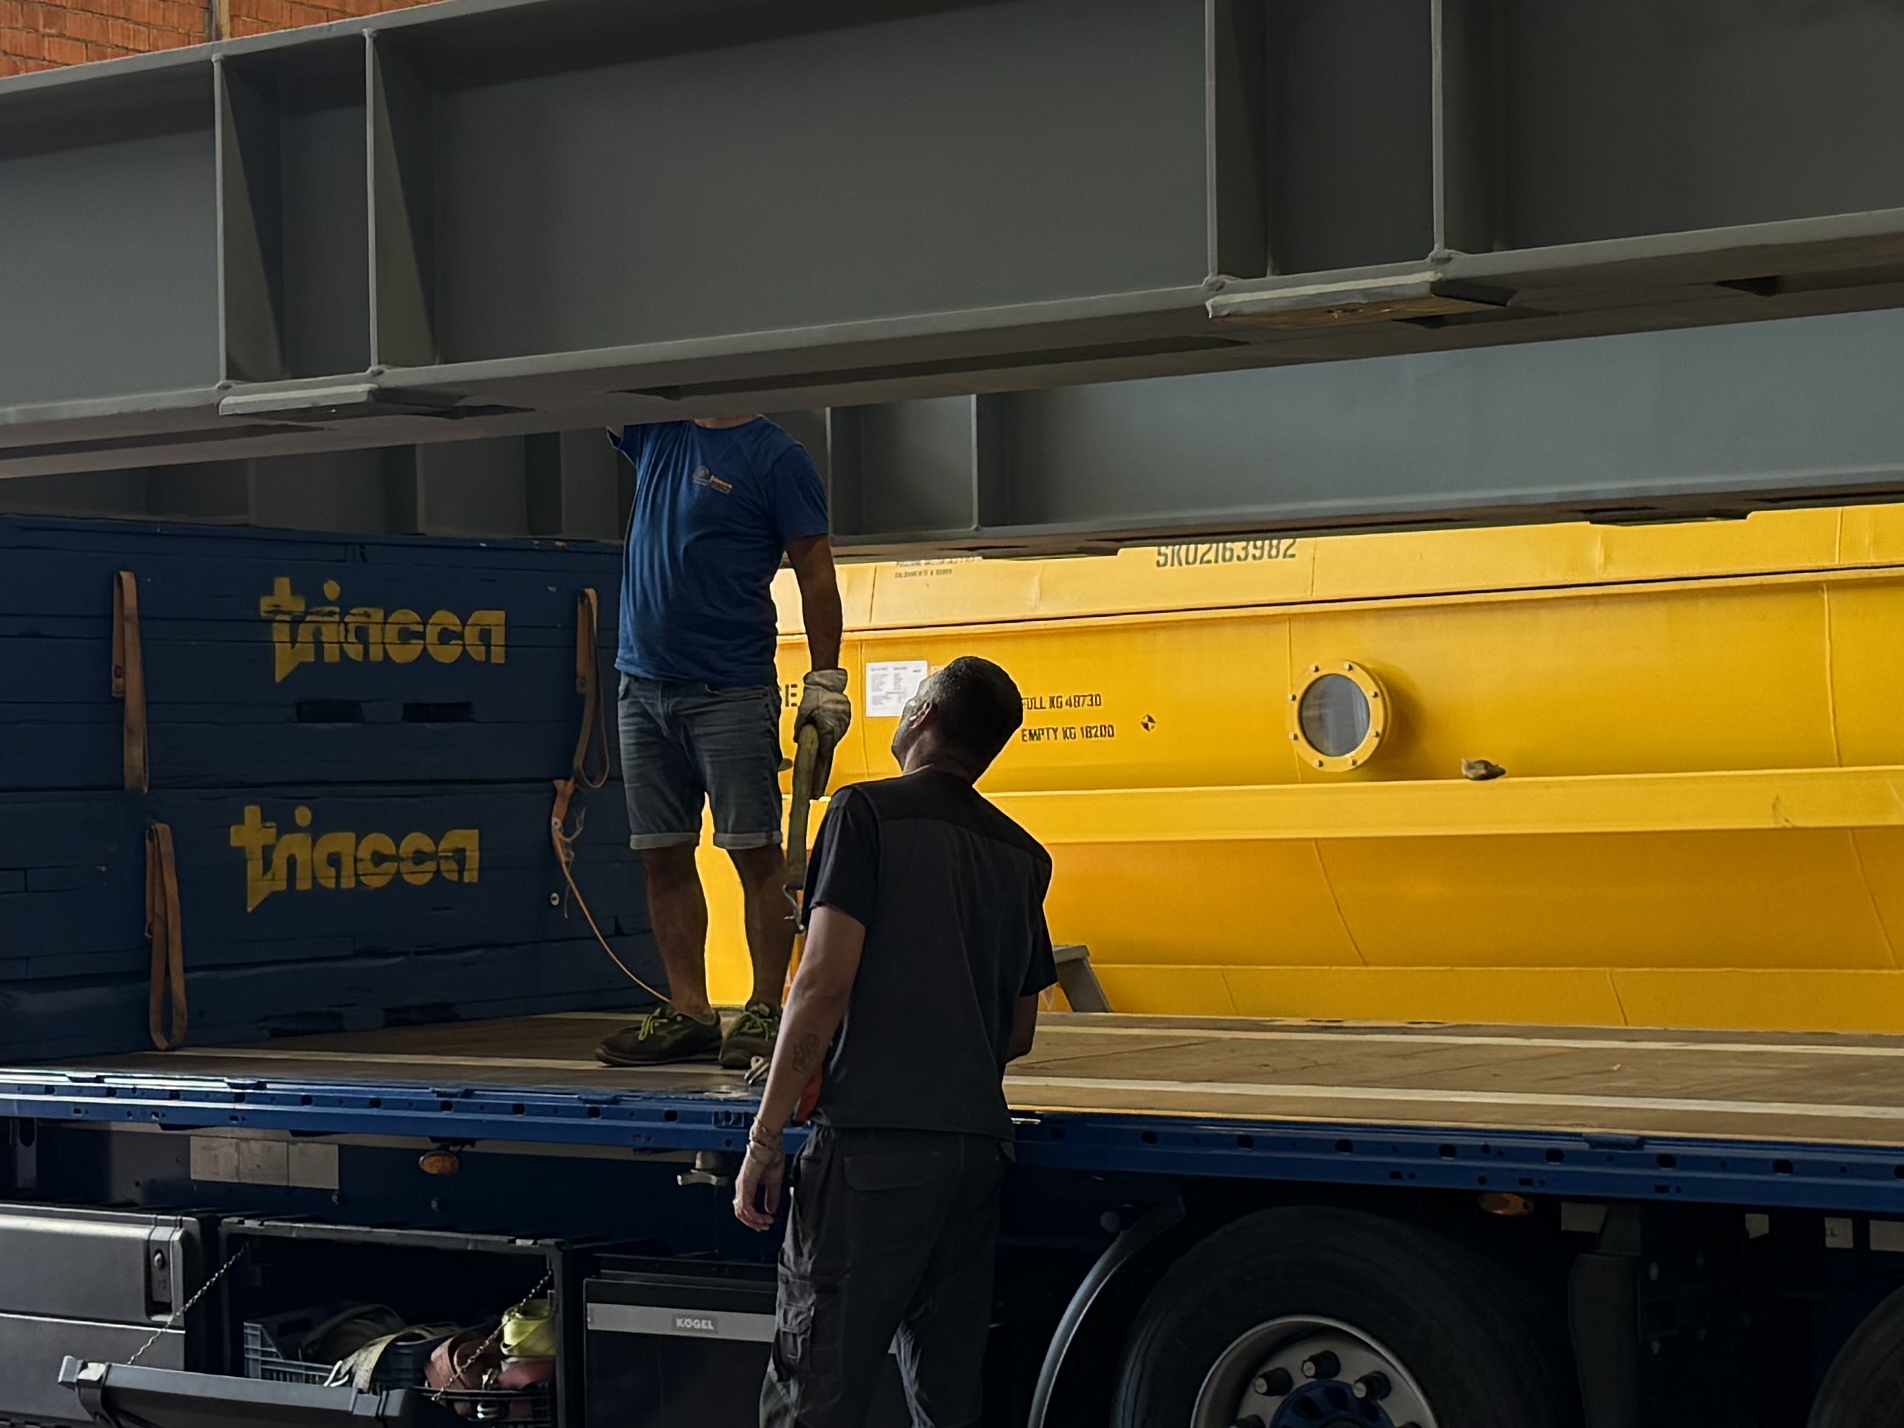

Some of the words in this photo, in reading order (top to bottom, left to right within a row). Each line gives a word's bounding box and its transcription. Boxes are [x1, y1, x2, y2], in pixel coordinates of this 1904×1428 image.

[260, 576, 506, 684] triacca
[1049, 695, 1063, 709] KG
[1065, 693, 1102, 708] 48730
[1021, 727, 1058, 742] EMPTY
[1062, 726, 1076, 741] KG
[1080, 724, 1115, 739] 18200
[230, 805, 480, 913] triacca
